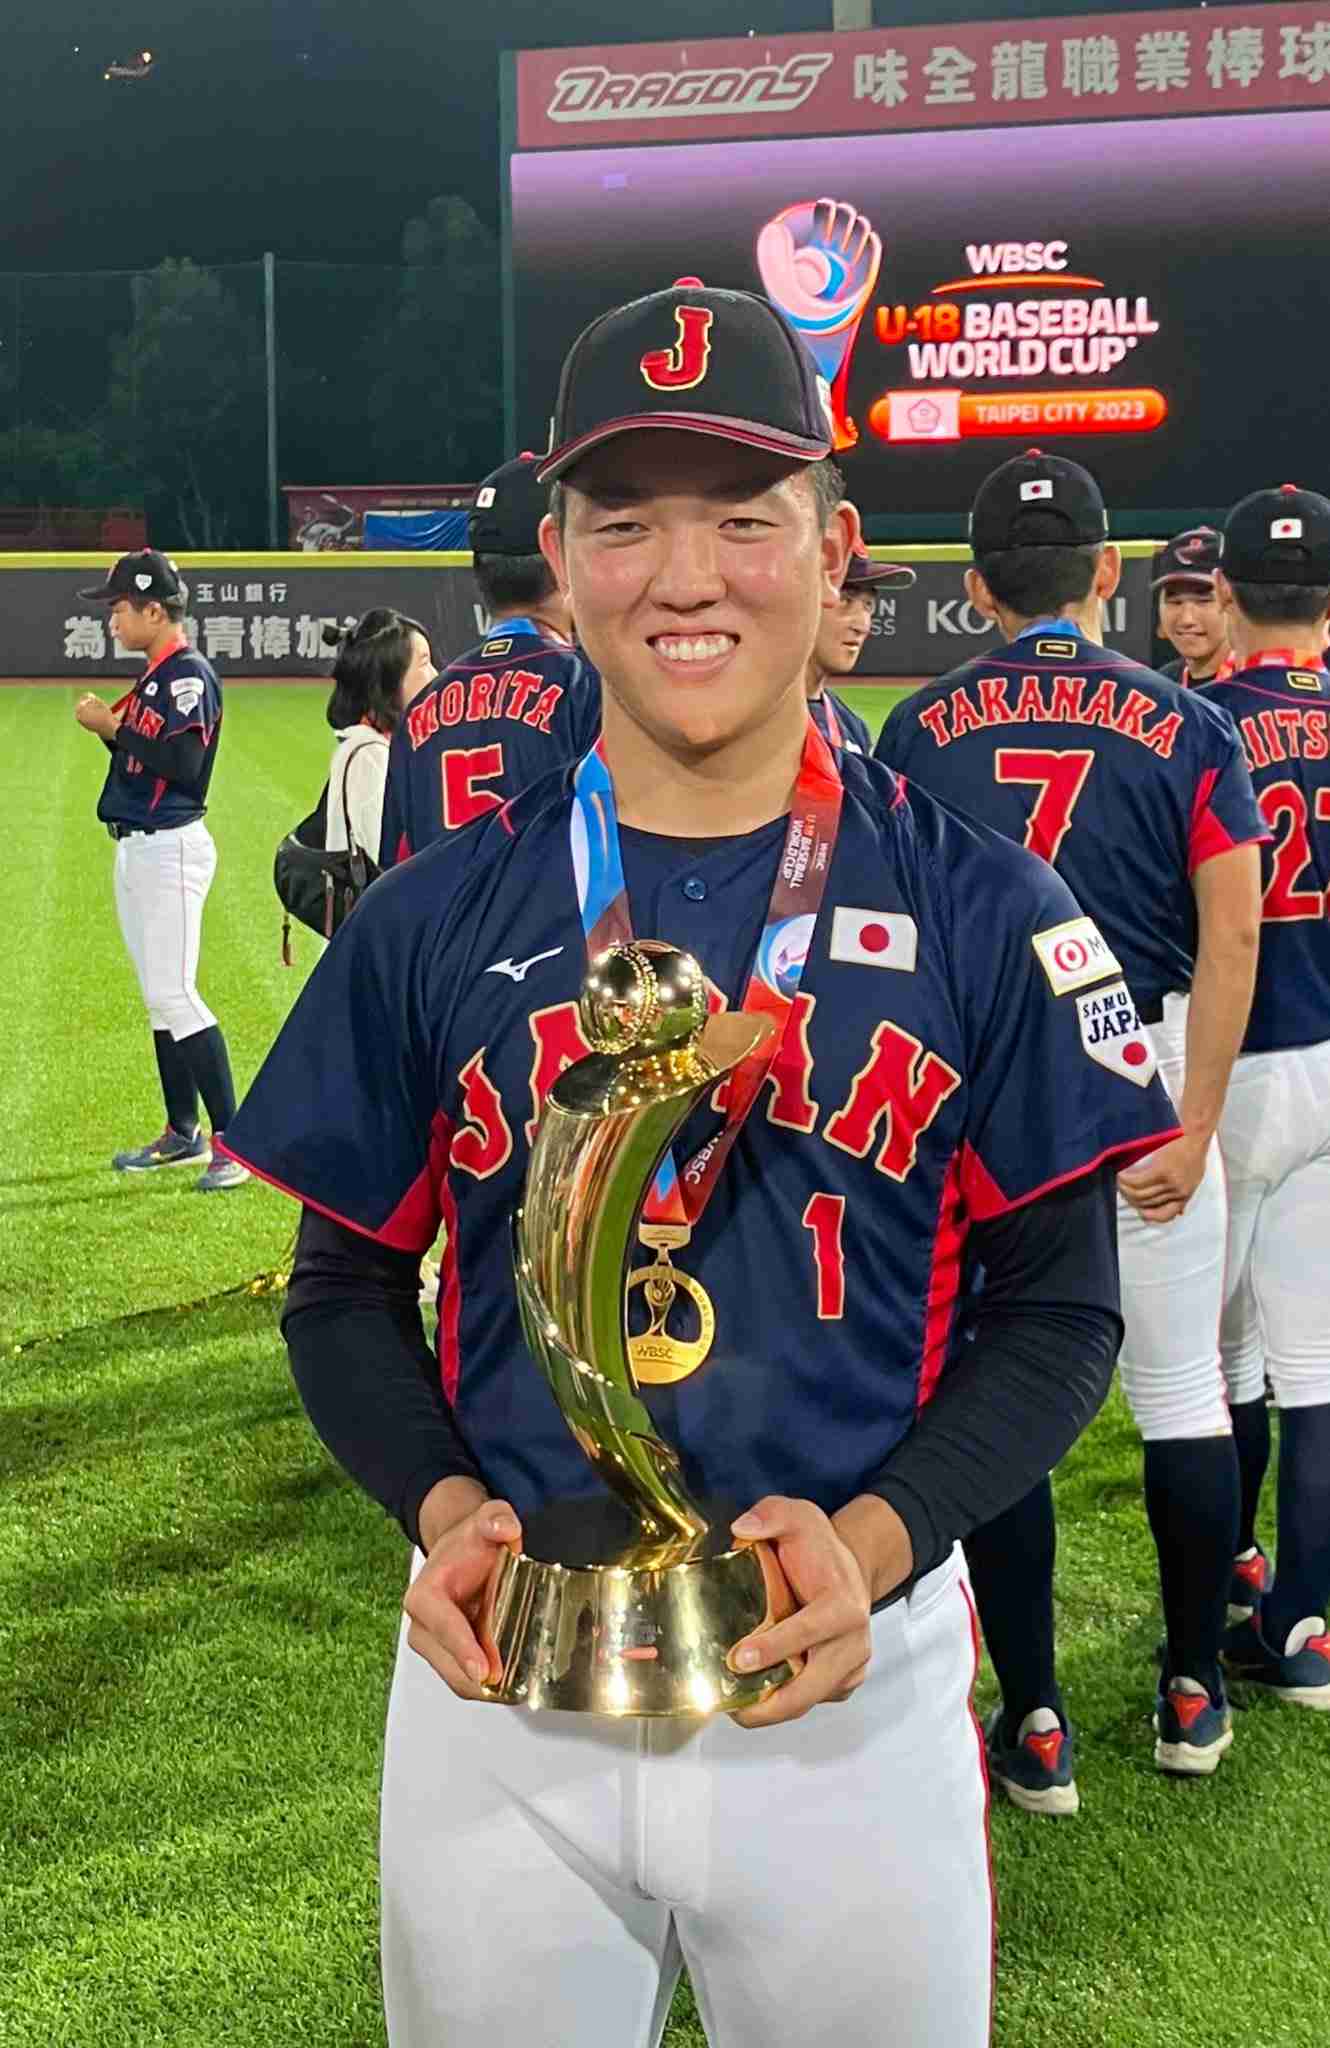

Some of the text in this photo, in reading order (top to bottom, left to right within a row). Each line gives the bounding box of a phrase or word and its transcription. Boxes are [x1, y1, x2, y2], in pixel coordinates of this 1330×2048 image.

[852, 23, 1330, 108] 味全龍職業棒球
[965, 240, 1068, 273] WBSC
[640, 305, 713, 391] J
[874, 297, 1159, 345] U-18 BASEBALL
[907, 336, 1128, 379] WORLD CUP
[974, 400, 1147, 424] TAIPEI CITY 2023
[407, 670, 564, 752] MORITA
[918, 675, 1185, 760] TAKANAKA
[995, 748, 1095, 866] 7
[449, 977, 962, 1182] JAAN
[802, 1191, 846, 1321] 1
[636, 1344, 673, 1359] WBSC
